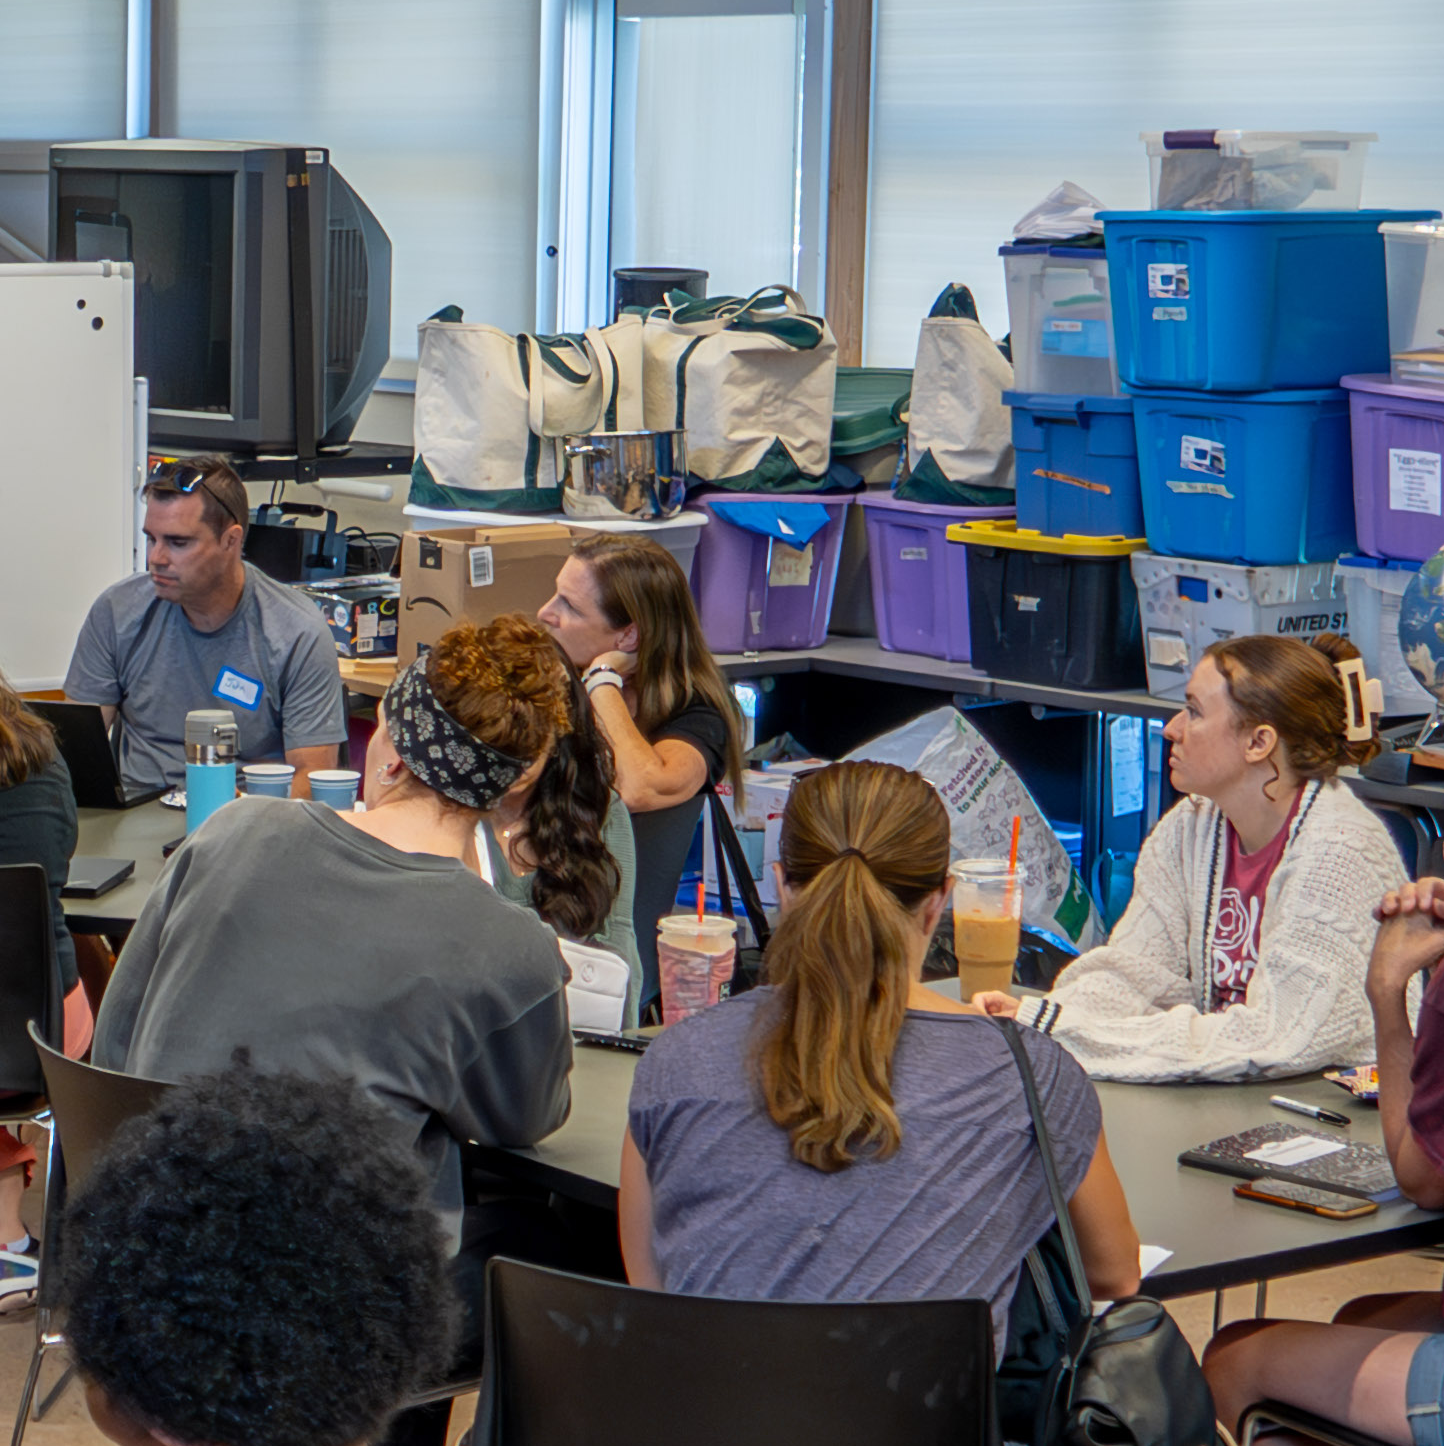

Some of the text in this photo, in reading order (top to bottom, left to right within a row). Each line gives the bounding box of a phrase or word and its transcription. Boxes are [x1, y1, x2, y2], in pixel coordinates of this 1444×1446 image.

[1277, 612, 1348, 634] UNITED ST
[940, 753, 980, 797] Fetched
[950, 759, 990, 806] our store
[957, 800, 971, 814] to
[969, 778, 990, 804] your
